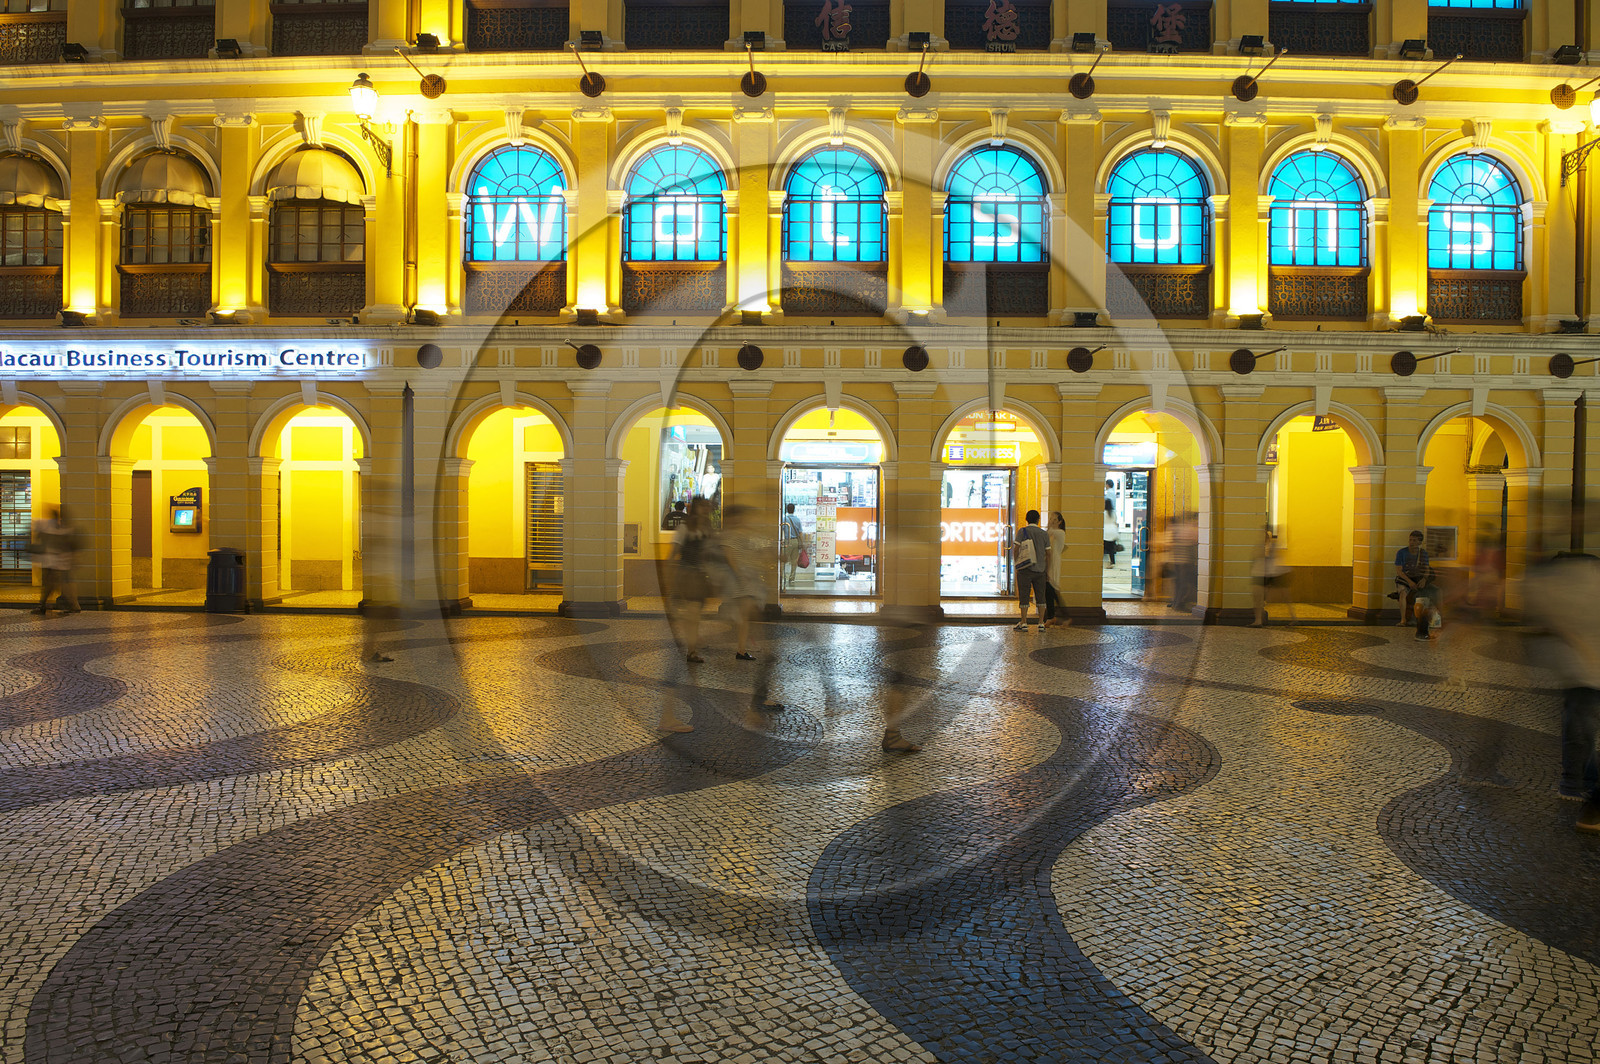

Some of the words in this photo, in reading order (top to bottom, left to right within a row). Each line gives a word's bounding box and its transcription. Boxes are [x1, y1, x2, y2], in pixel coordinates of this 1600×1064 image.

[67, 350, 166, 367] Business
[175, 350, 267, 367] Tourism
[280, 349, 360, 366] Centre
[966, 447, 1014, 459] FORTRESS
